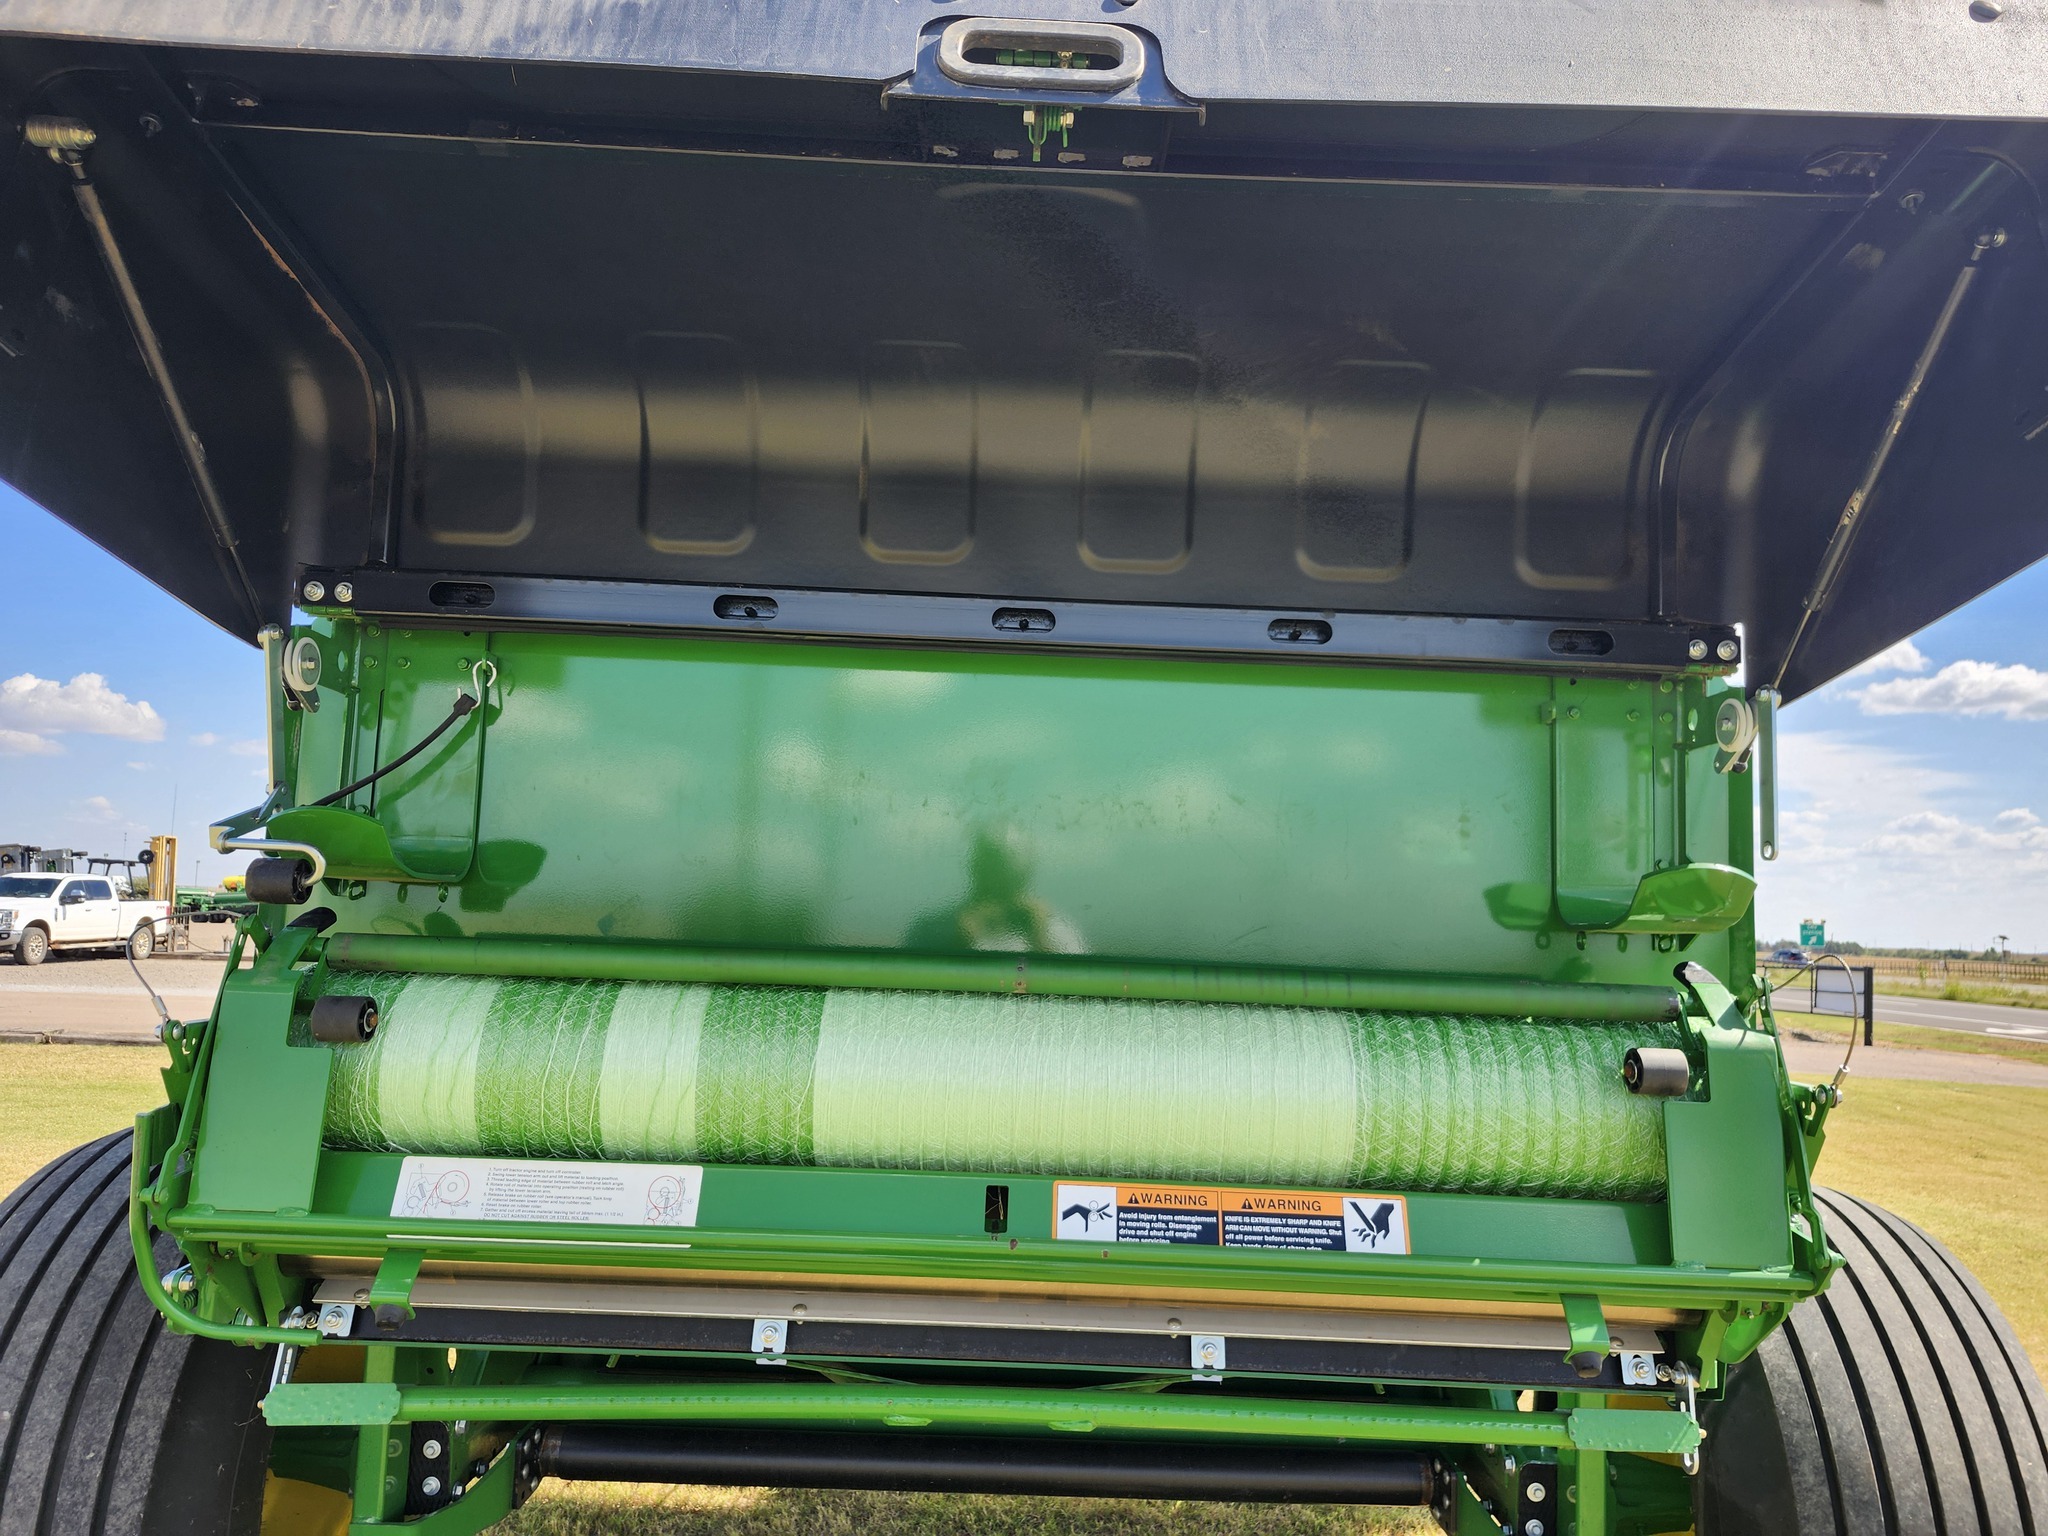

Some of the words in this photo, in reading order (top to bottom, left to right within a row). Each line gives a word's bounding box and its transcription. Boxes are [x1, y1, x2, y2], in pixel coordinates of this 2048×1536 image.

[1140, 1193, 1207, 1206] WARNING
[1254, 1198, 1321, 1211] WARNING
[1139, 1213, 1157, 1221] injury
[1174, 1215, 1217, 1223] entanglement
[1251, 1217, 1286, 1225] EXTREMELY
[1169, 1222, 1202, 1230] Disengage
